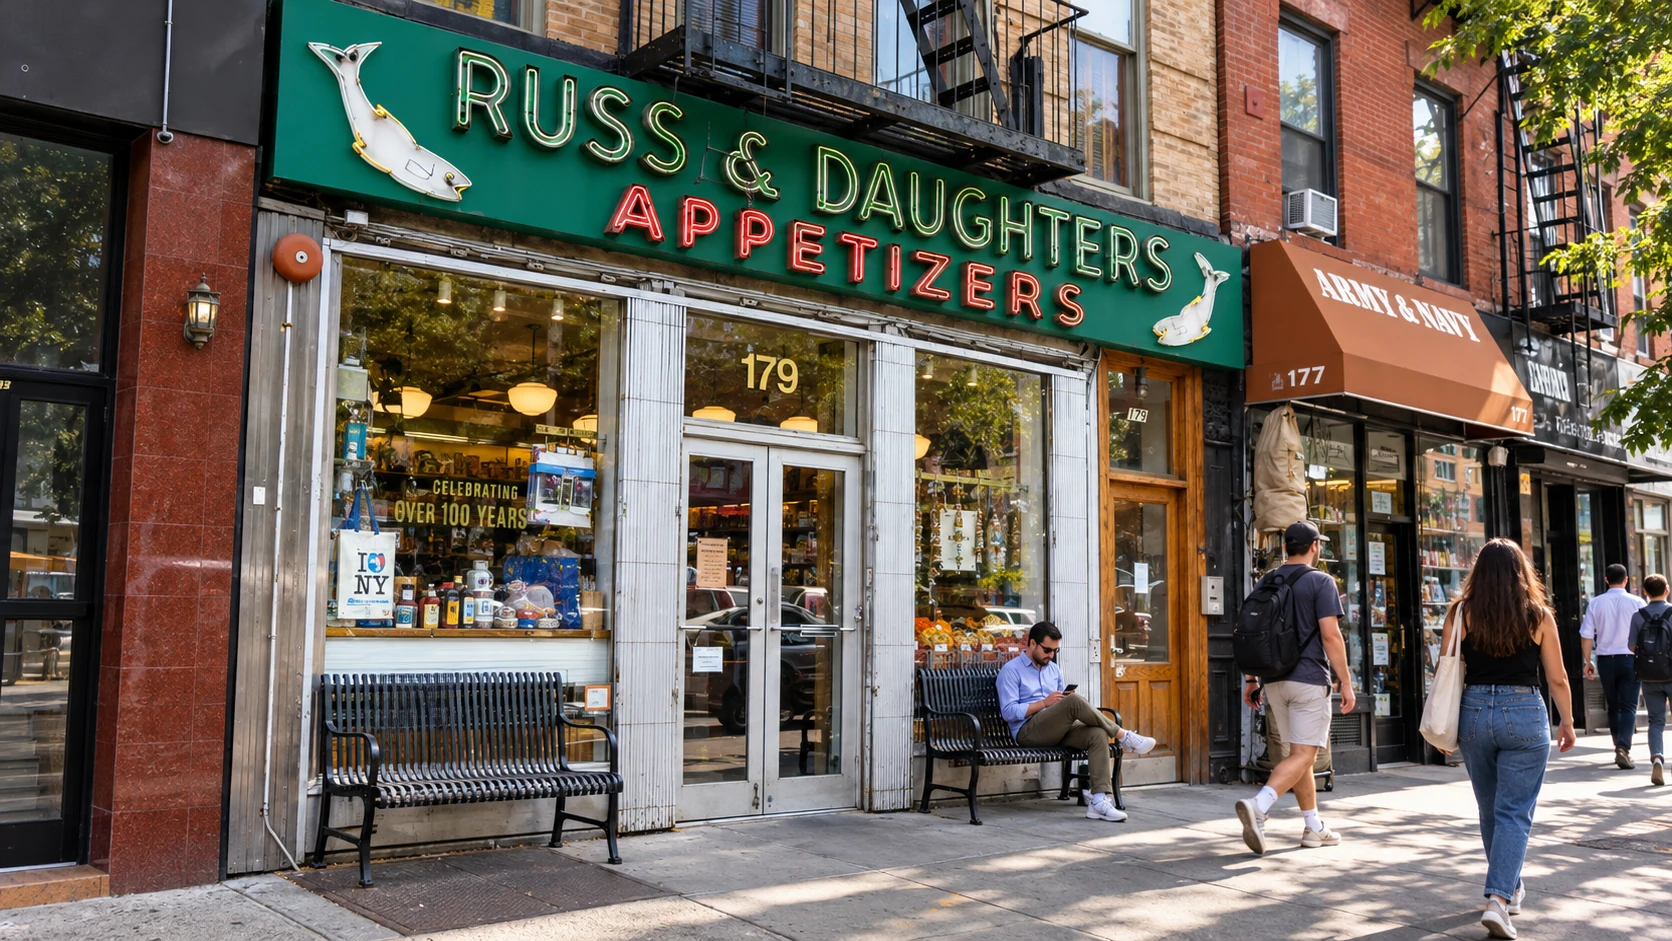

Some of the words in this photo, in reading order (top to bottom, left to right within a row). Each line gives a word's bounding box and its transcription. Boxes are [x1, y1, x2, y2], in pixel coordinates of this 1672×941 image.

[452, 47, 689, 177] RUSS
[720, 131, 780, 201] &
[811, 144, 1173, 293] DAUGHTERS
[604, 183, 1086, 328] APPETIZERS
[1313, 268, 1398, 318] ARMY
[1395, 294, 1420, 325] &
[1411, 298, 1480, 342] NAVY
[741, 353, 798, 394] 179
[1287, 365, 1325, 387] 177
[1129, 408, 1148, 421] 179
[1511, 406, 1527, 423] 177
[433, 479, 518, 500] CELEBRATING
[394, 500, 435, 524] OVER
[441, 502, 470, 527] 100
[477, 504, 527, 530] YEARS
[357, 552, 367, 572] I
[354, 575, 389, 594] NY
